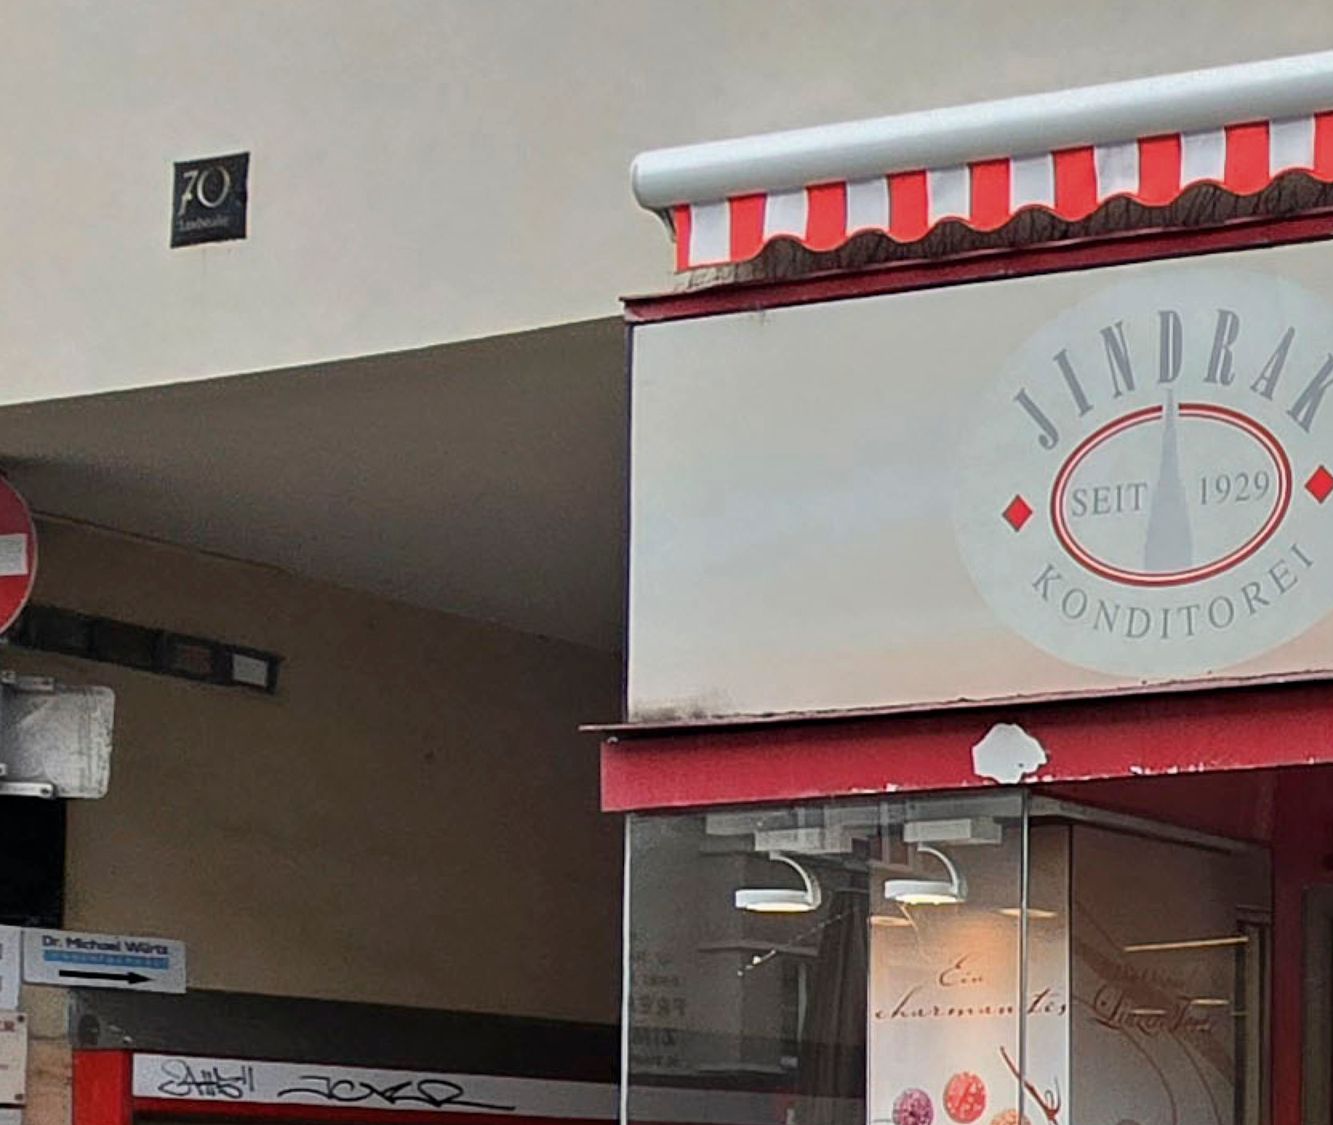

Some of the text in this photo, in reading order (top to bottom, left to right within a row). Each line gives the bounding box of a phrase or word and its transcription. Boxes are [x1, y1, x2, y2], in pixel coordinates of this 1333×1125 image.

[178, 165, 231, 216] 70
[1071, 470, 1271, 517] SEIT 1929
[1031, 541, 1315, 640] KONDITOREI
